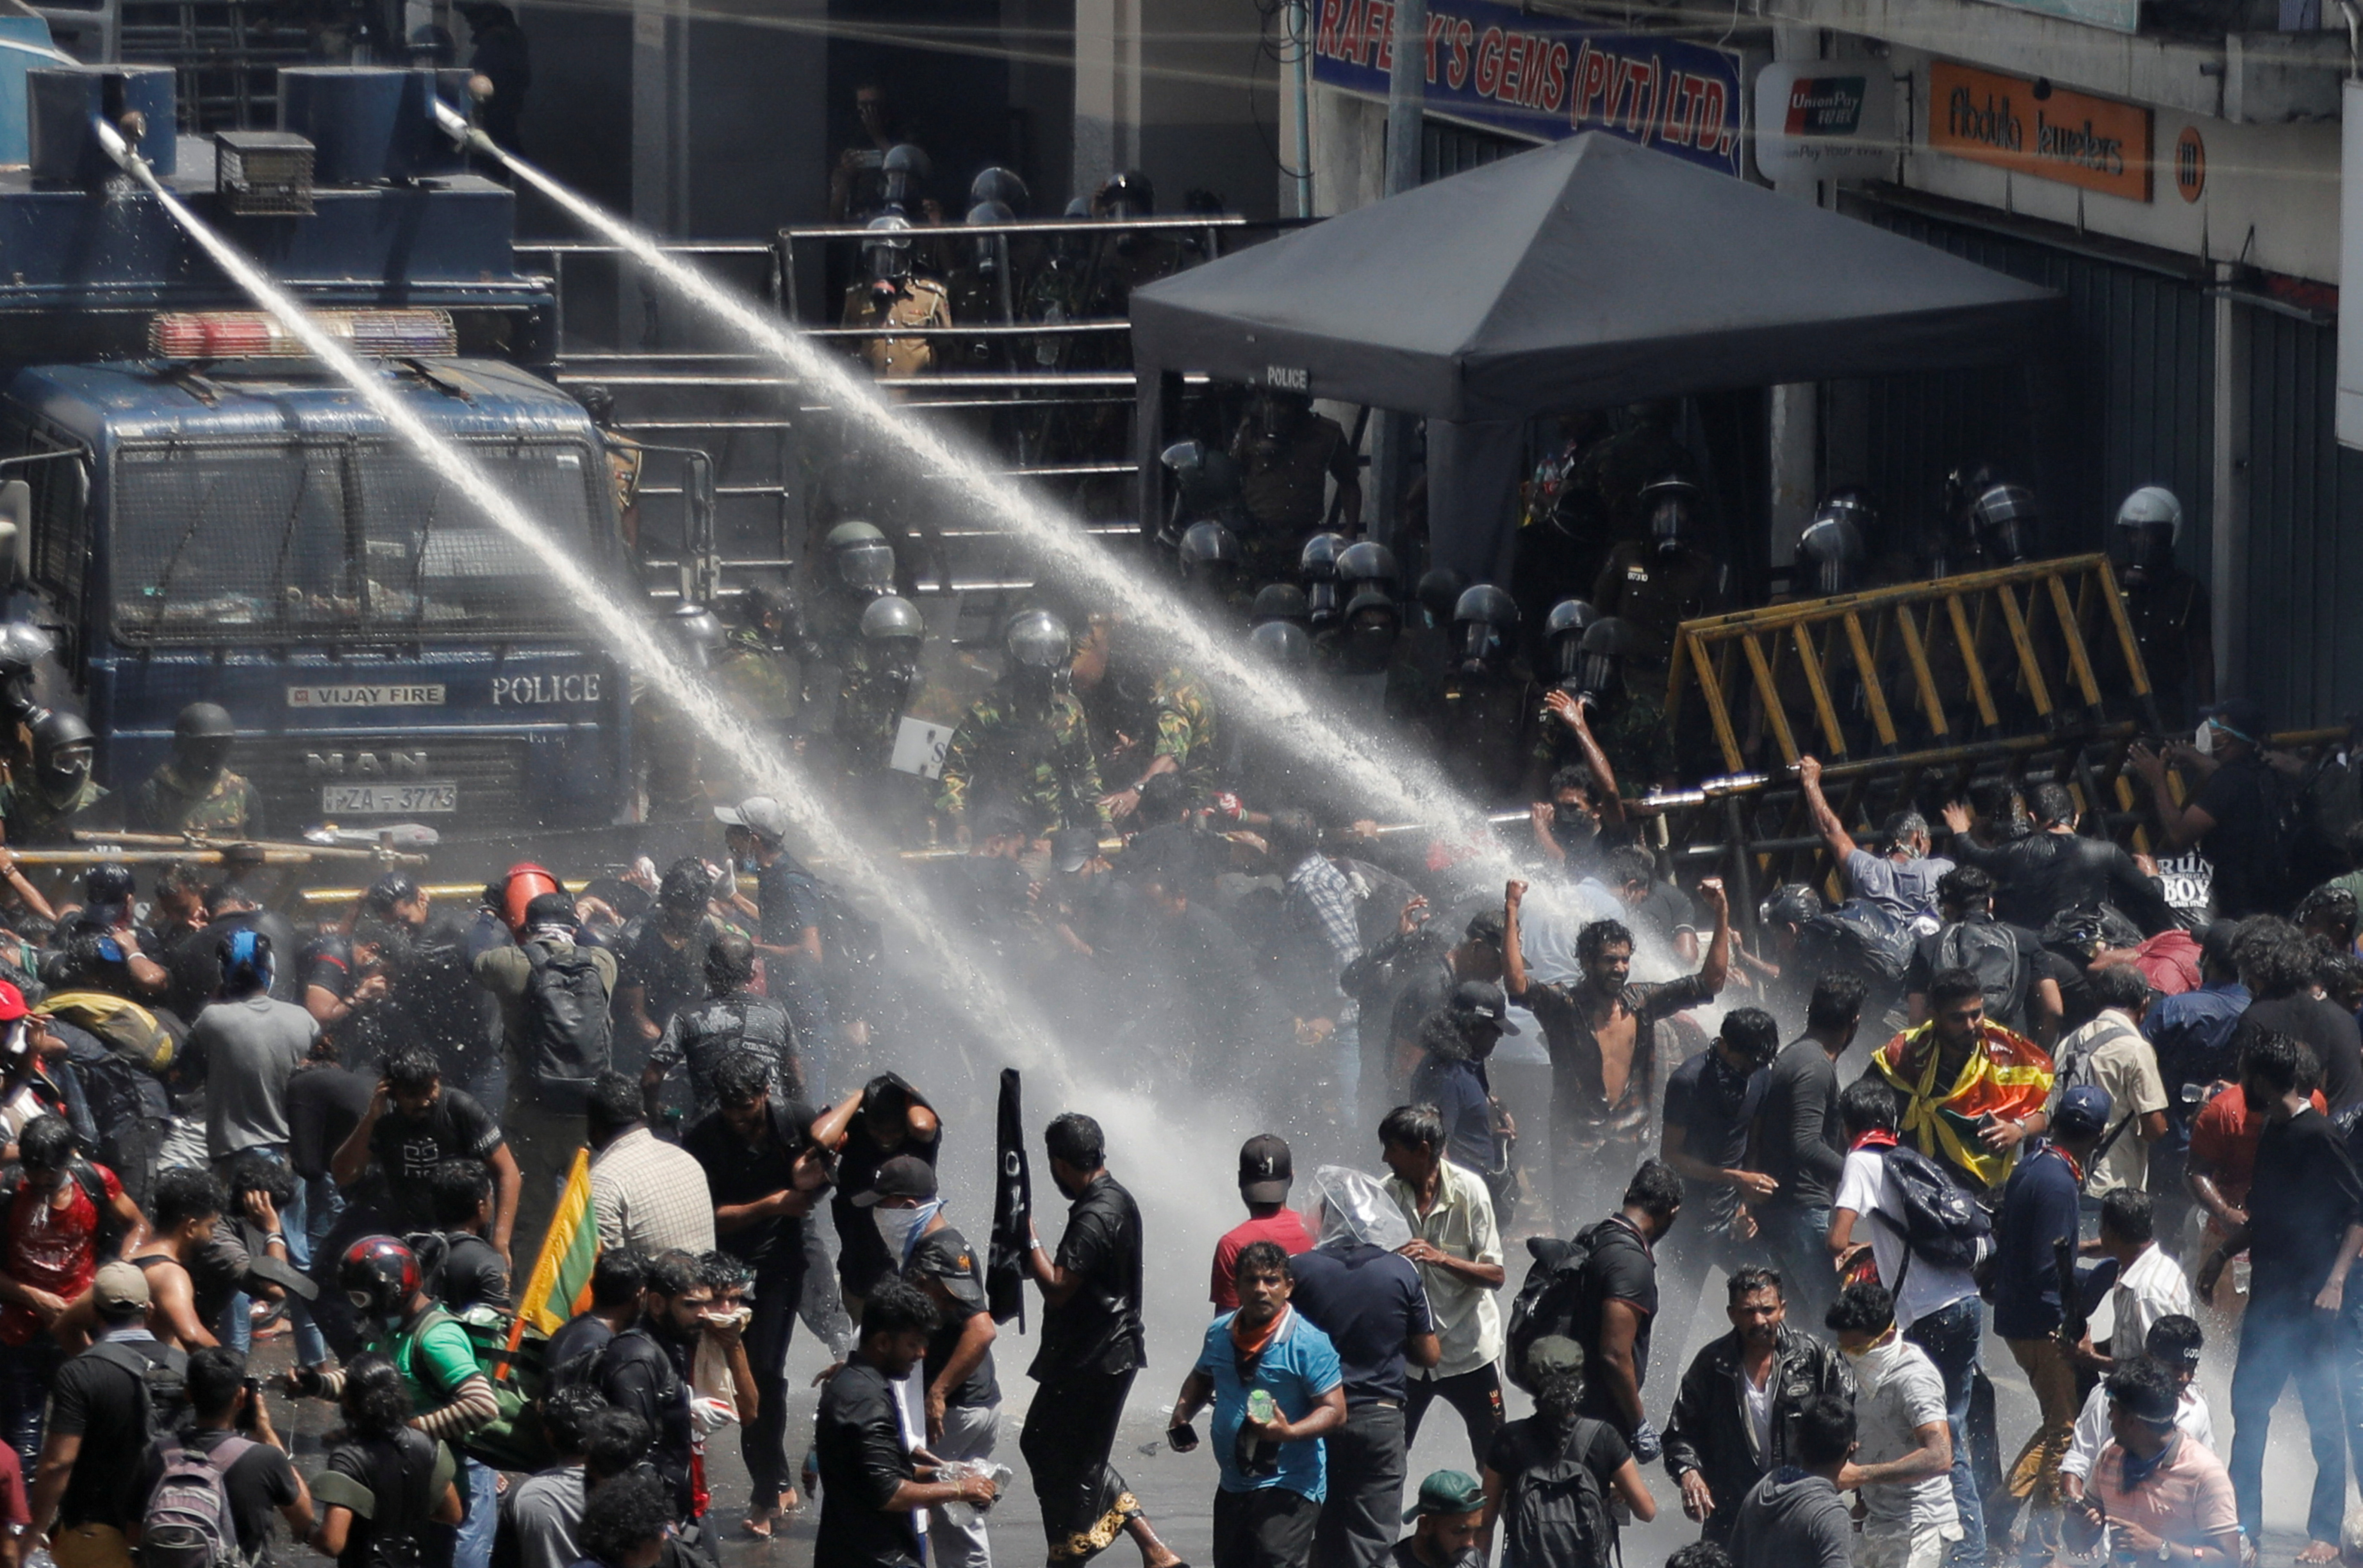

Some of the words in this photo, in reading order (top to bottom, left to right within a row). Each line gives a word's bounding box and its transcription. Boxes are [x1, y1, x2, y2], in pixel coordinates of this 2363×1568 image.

[1316, 0, 1473, 90] RAFEK'S
[1475, 26, 1568, 113] GEMS
[1571, 39, 1662, 146] (PVT)
[1661, 70, 1734, 156] LTD.
[1792, 92, 1859, 112] UnionPay
[1950, 87, 2022, 151] Abdulla
[2036, 110, 2123, 176] Jewellers
[1267, 366, 1307, 389] POLICE
[318, 688, 380, 703] VIJAY
[390, 687, 440, 702] FIRE
[492, 673, 601, 705] POLICE
[307, 752, 427, 774] MAN
[400, 785, 457, 809] 3773
[2157, 857, 2214, 876] RUN
[2160, 876, 2210, 903] BOY
[1259, 1156, 1273, 1174] +1
